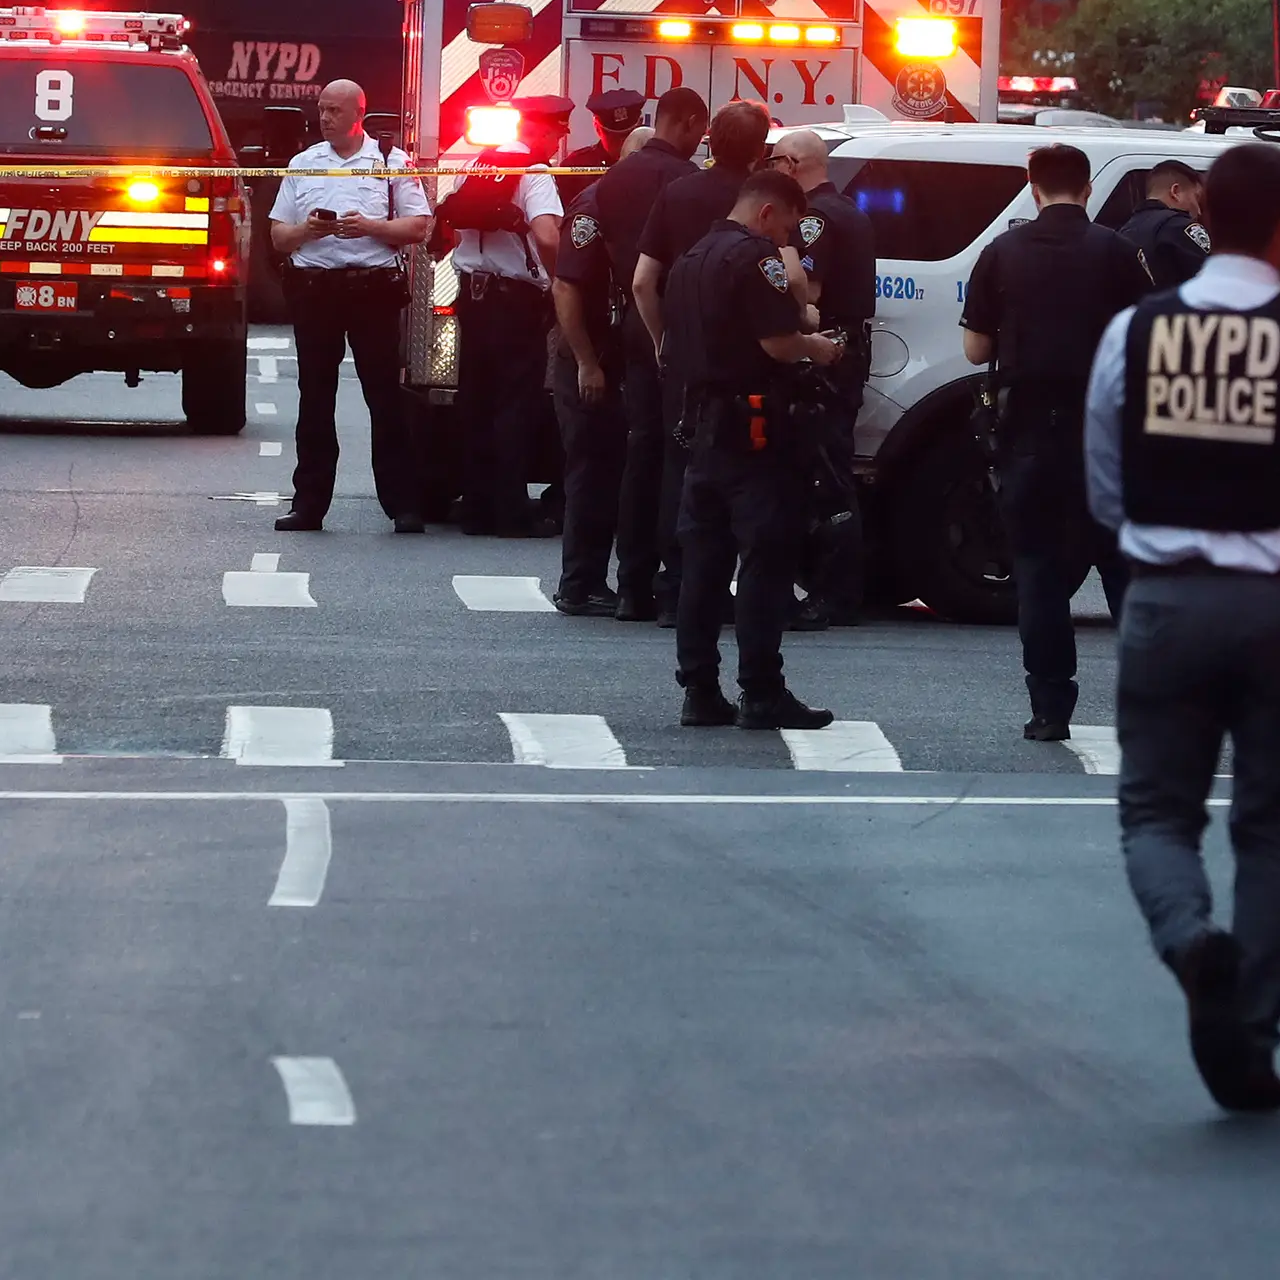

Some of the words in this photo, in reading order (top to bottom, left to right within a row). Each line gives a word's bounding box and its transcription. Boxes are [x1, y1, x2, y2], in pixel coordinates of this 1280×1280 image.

[226, 41, 321, 82] NYPD
[34, 69, 74, 122] 8
[2, 208, 106, 242] FDNY
[26, 241, 57, 252] BACK
[62, 243, 83, 253] 200
[87, 244, 115, 254] FEET
[38, 285, 55, 308] 8
[57, 296, 76, 308] BN
[915, 288, 925, 300] 17
[1146, 374, 1278, 426] POLICE
